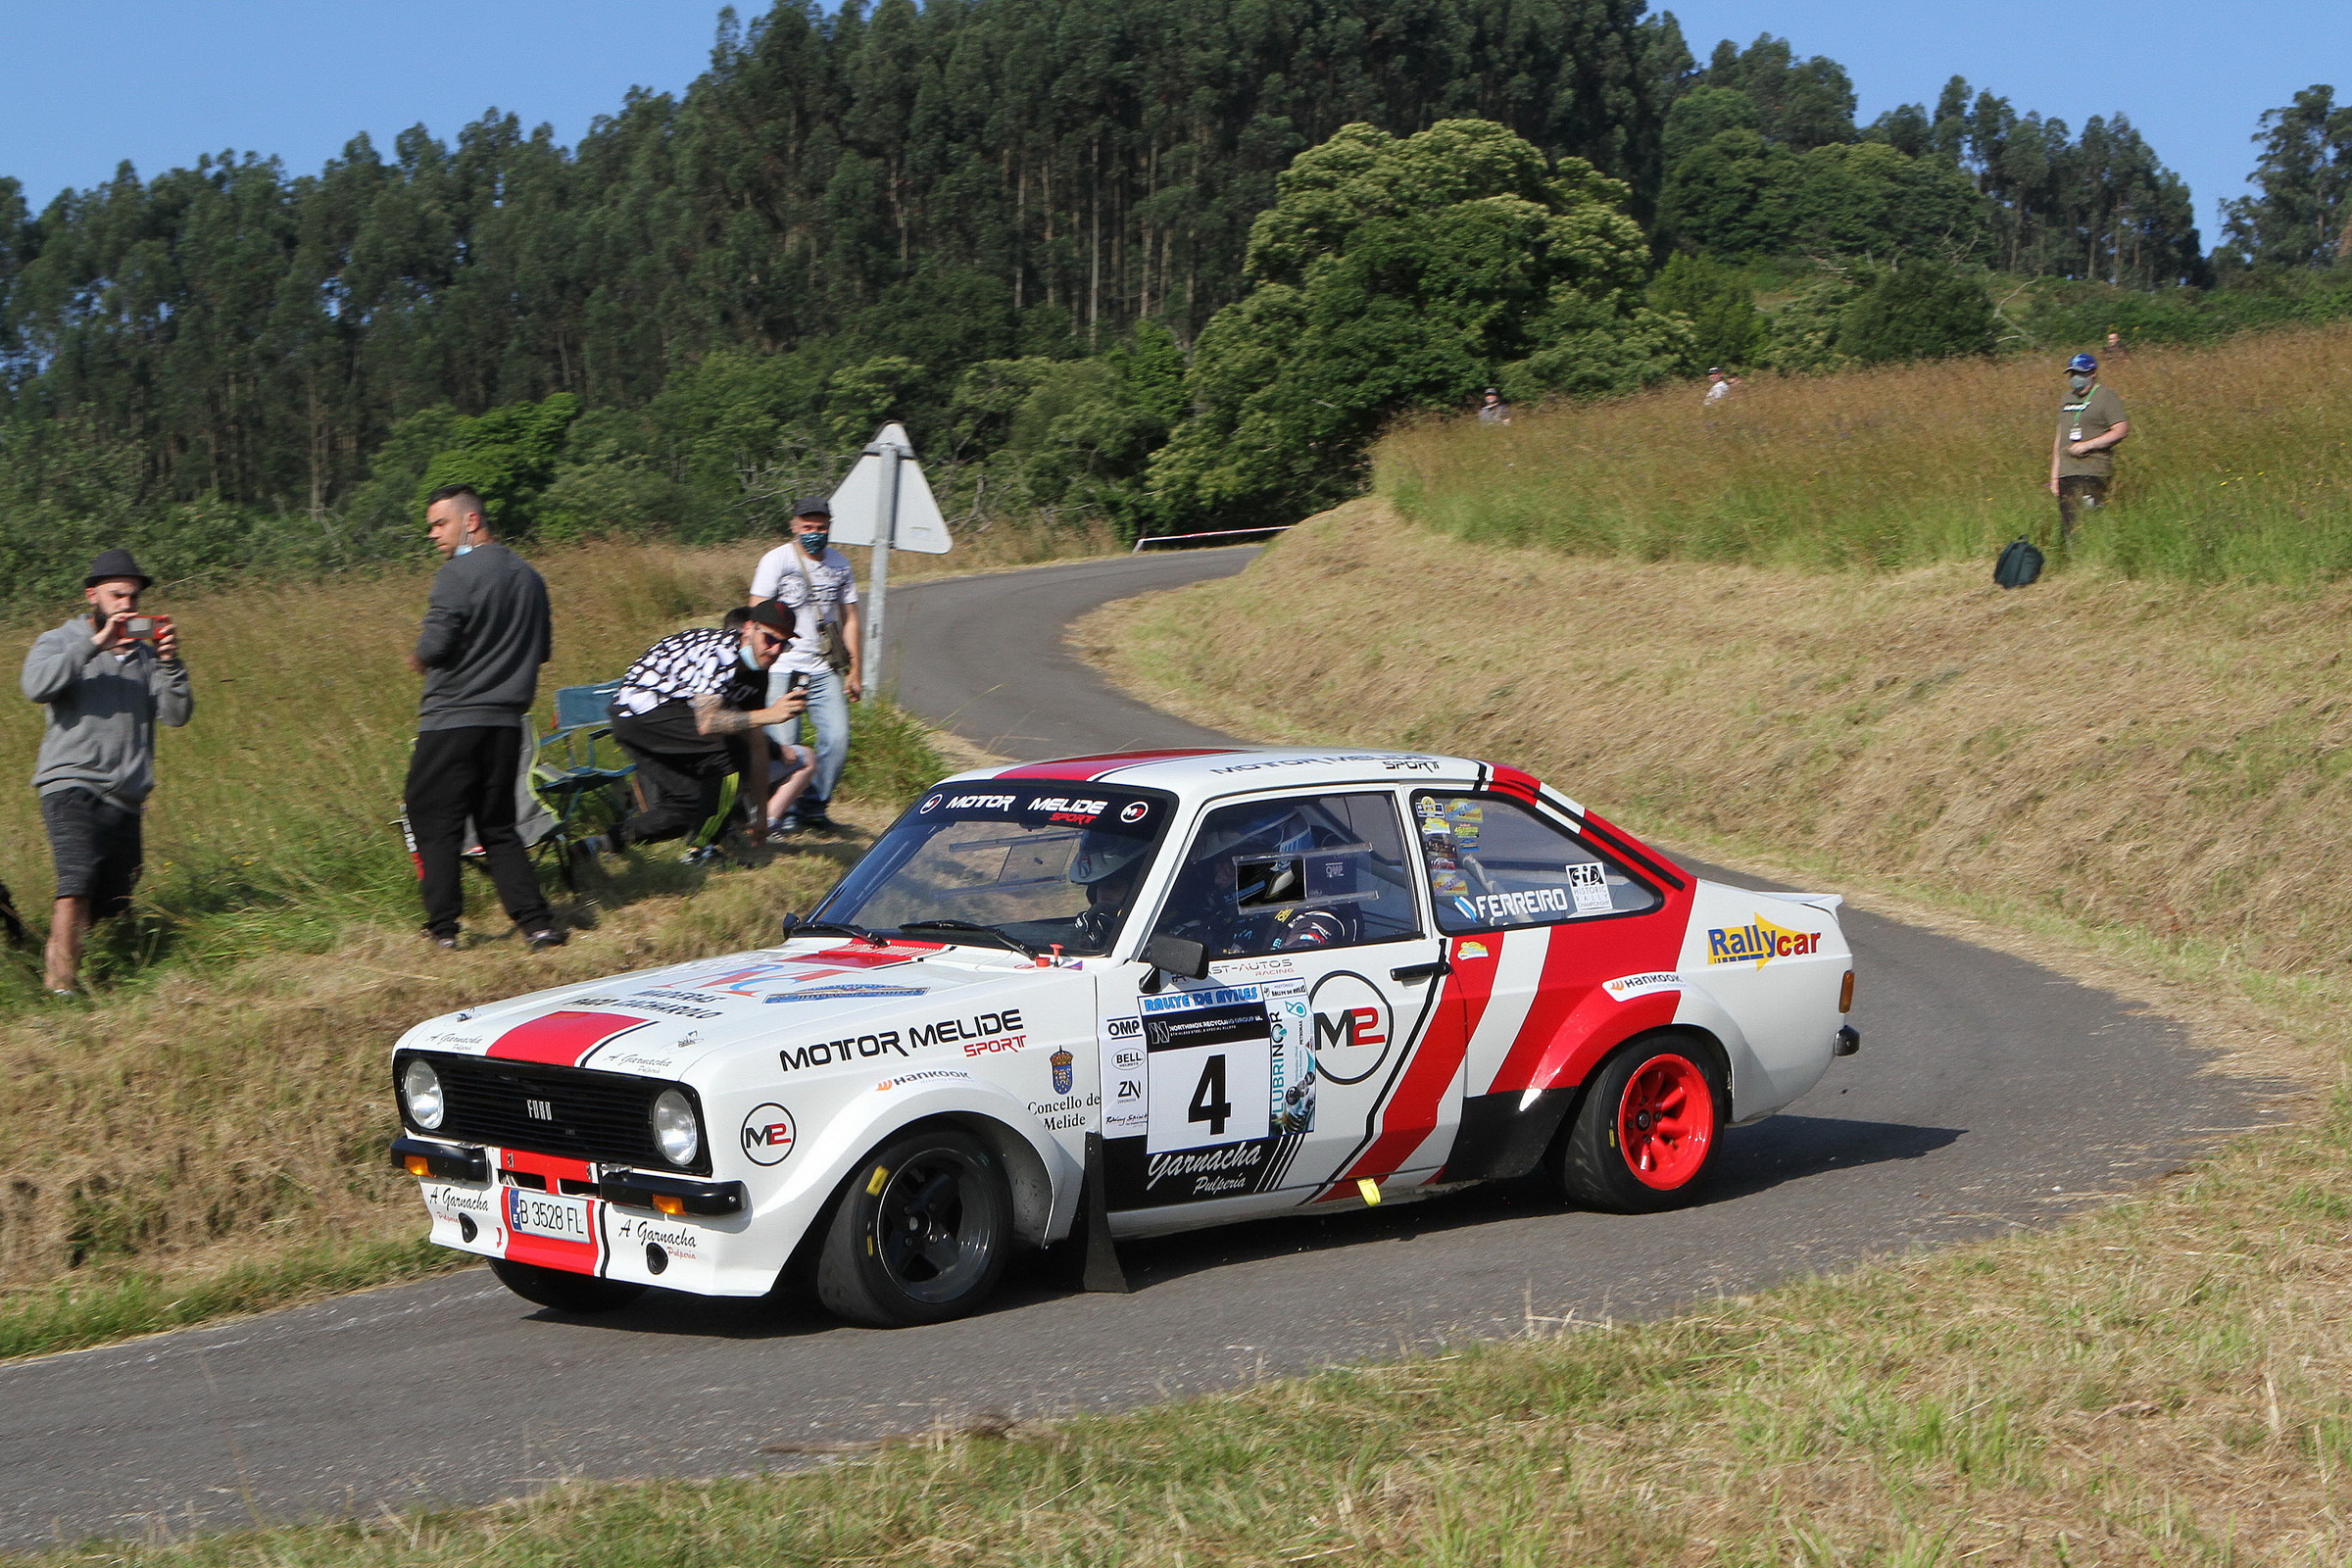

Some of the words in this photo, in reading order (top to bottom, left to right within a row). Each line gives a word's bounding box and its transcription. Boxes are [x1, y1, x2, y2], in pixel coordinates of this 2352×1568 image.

[1209, 758, 1334, 774] MOTOR
[1386, 760, 1441, 773] SPORT
[945, 795, 1016, 812] MOTOR
[1028, 797, 1108, 815] MELIDE
[1050, 812, 1098, 825] SPORT
[1574, 886, 1606, 895] HISTORIC
[1476, 888, 1569, 919] FERREIRO
[1707, 924, 1822, 958] Rallycar
[1255, 967, 1295, 977] RACING
[1144, 994, 1190, 1011] RALLYE
[1193, 991, 1213, 1005] DE
[1216, 987, 1258, 1004] AVILES
[1108, 1019, 1140, 1036] OMP
[1313, 1006, 1387, 1052] M2
[779, 1031, 909, 1072] MOTOR
[907, 1008, 1024, 1049] MELIDE
[963, 1035, 1027, 1058] SPORT
[1116, 1052, 1142, 1064] BELL
[1269, 1010, 1287, 1114] LUBRINOR
[1027, 1095, 1083, 1115] Concello
[1086, 1092, 1101, 1106] de
[1188, 1054, 1232, 1136] 4
[526, 1099, 553, 1121] FORD
[1044, 1112, 1086, 1131] Melide
[746, 1122, 792, 1149] M2
[1146, 1141, 1262, 1191] Garnacha
[429, 1186, 439, 1204] A
[442, 1187, 490, 1211] Garnacha
[513, 1214, 518, 1224] E
[519, 1199, 529, 1224] B
[531, 1201, 564, 1231] 3528
[566, 1206, 585, 1235] FL
[618, 1218, 632, 1238] A
[637, 1221, 698, 1248] Garnacha
